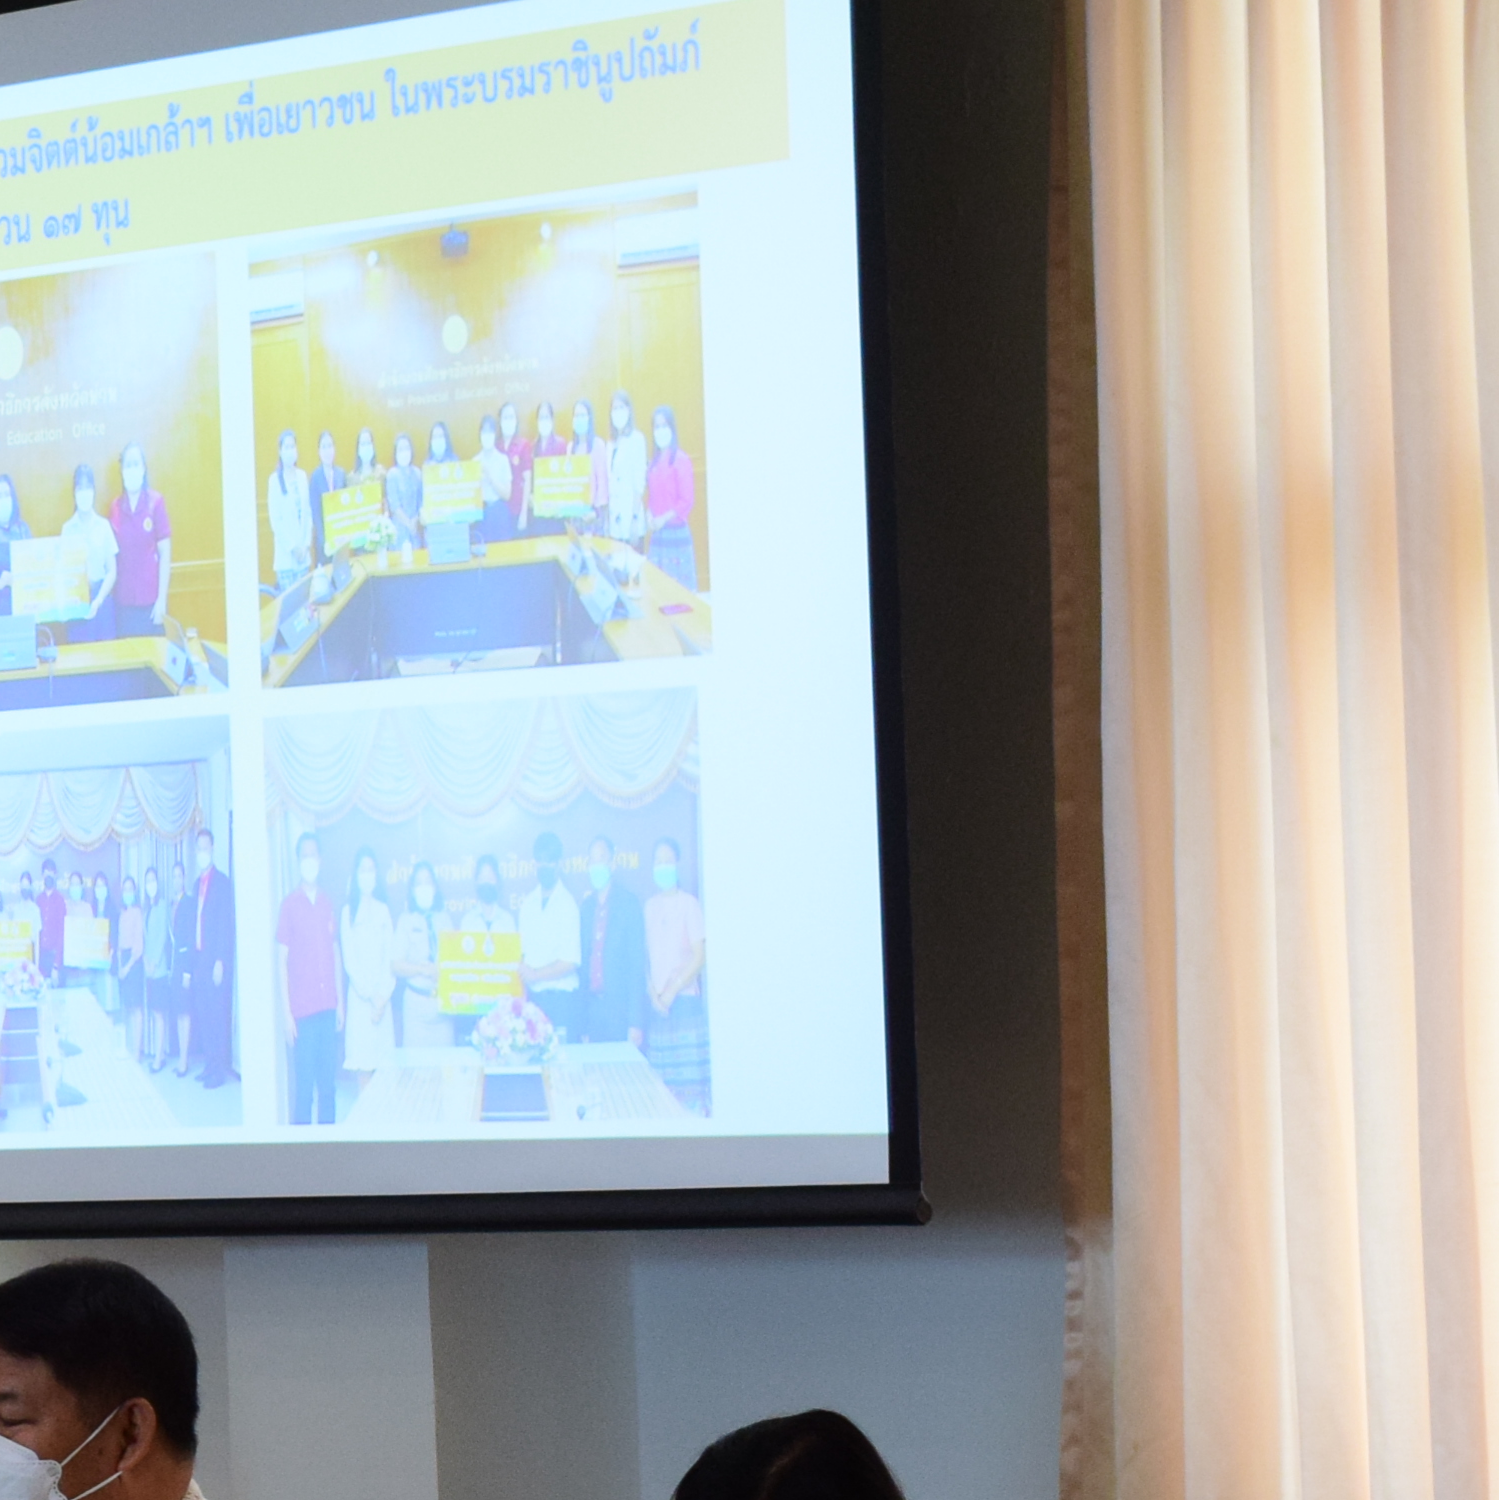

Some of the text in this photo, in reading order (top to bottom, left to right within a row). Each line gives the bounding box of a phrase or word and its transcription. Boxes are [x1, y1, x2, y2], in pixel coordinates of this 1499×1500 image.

[224, 80, 376, 143] เพื่อเยาวชน
[384, 18, 701, 117] ในพระบรมราชินูปถัมภ์
[43, 206, 82, 239] ๑๗
[93, 198, 130, 247] ทุน
[6, 427, 63, 447] Education
[72, 421, 106, 438] Office
